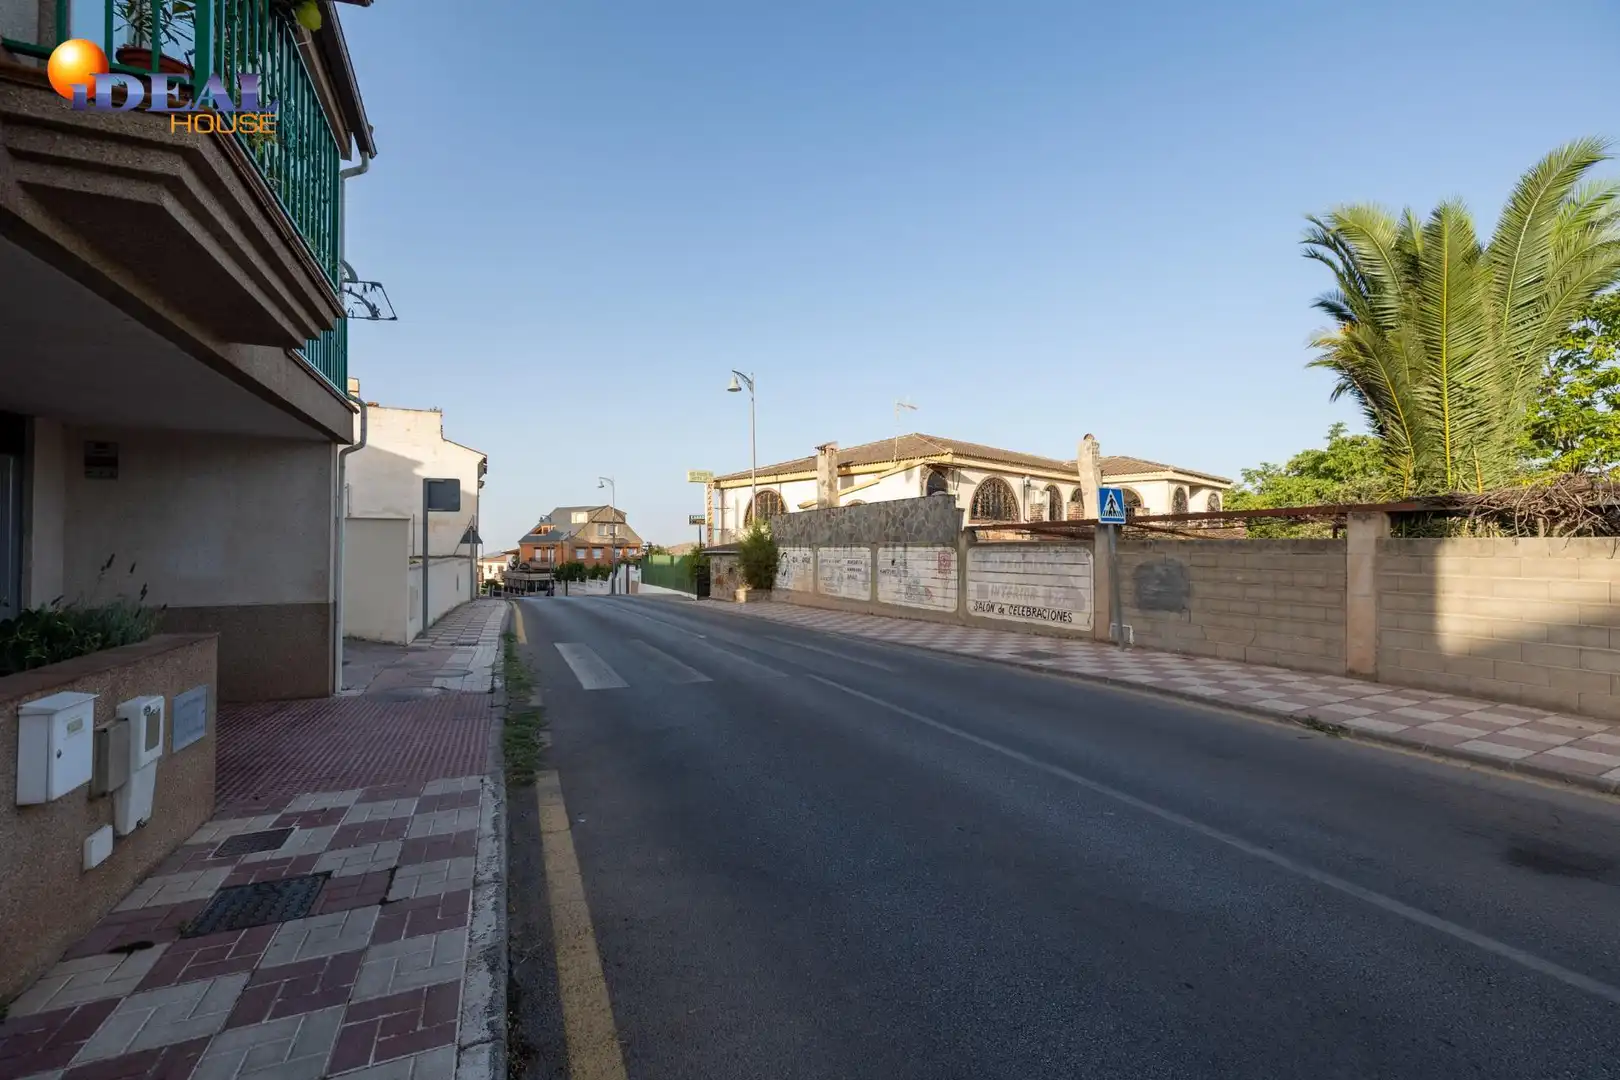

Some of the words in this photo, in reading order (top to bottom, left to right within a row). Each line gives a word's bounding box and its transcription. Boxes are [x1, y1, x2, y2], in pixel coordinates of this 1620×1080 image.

[973, 600, 995, 613] SALÓN
[997, 604, 1005, 614] de
[1008, 605, 1073, 623] CELEBRACIONES
